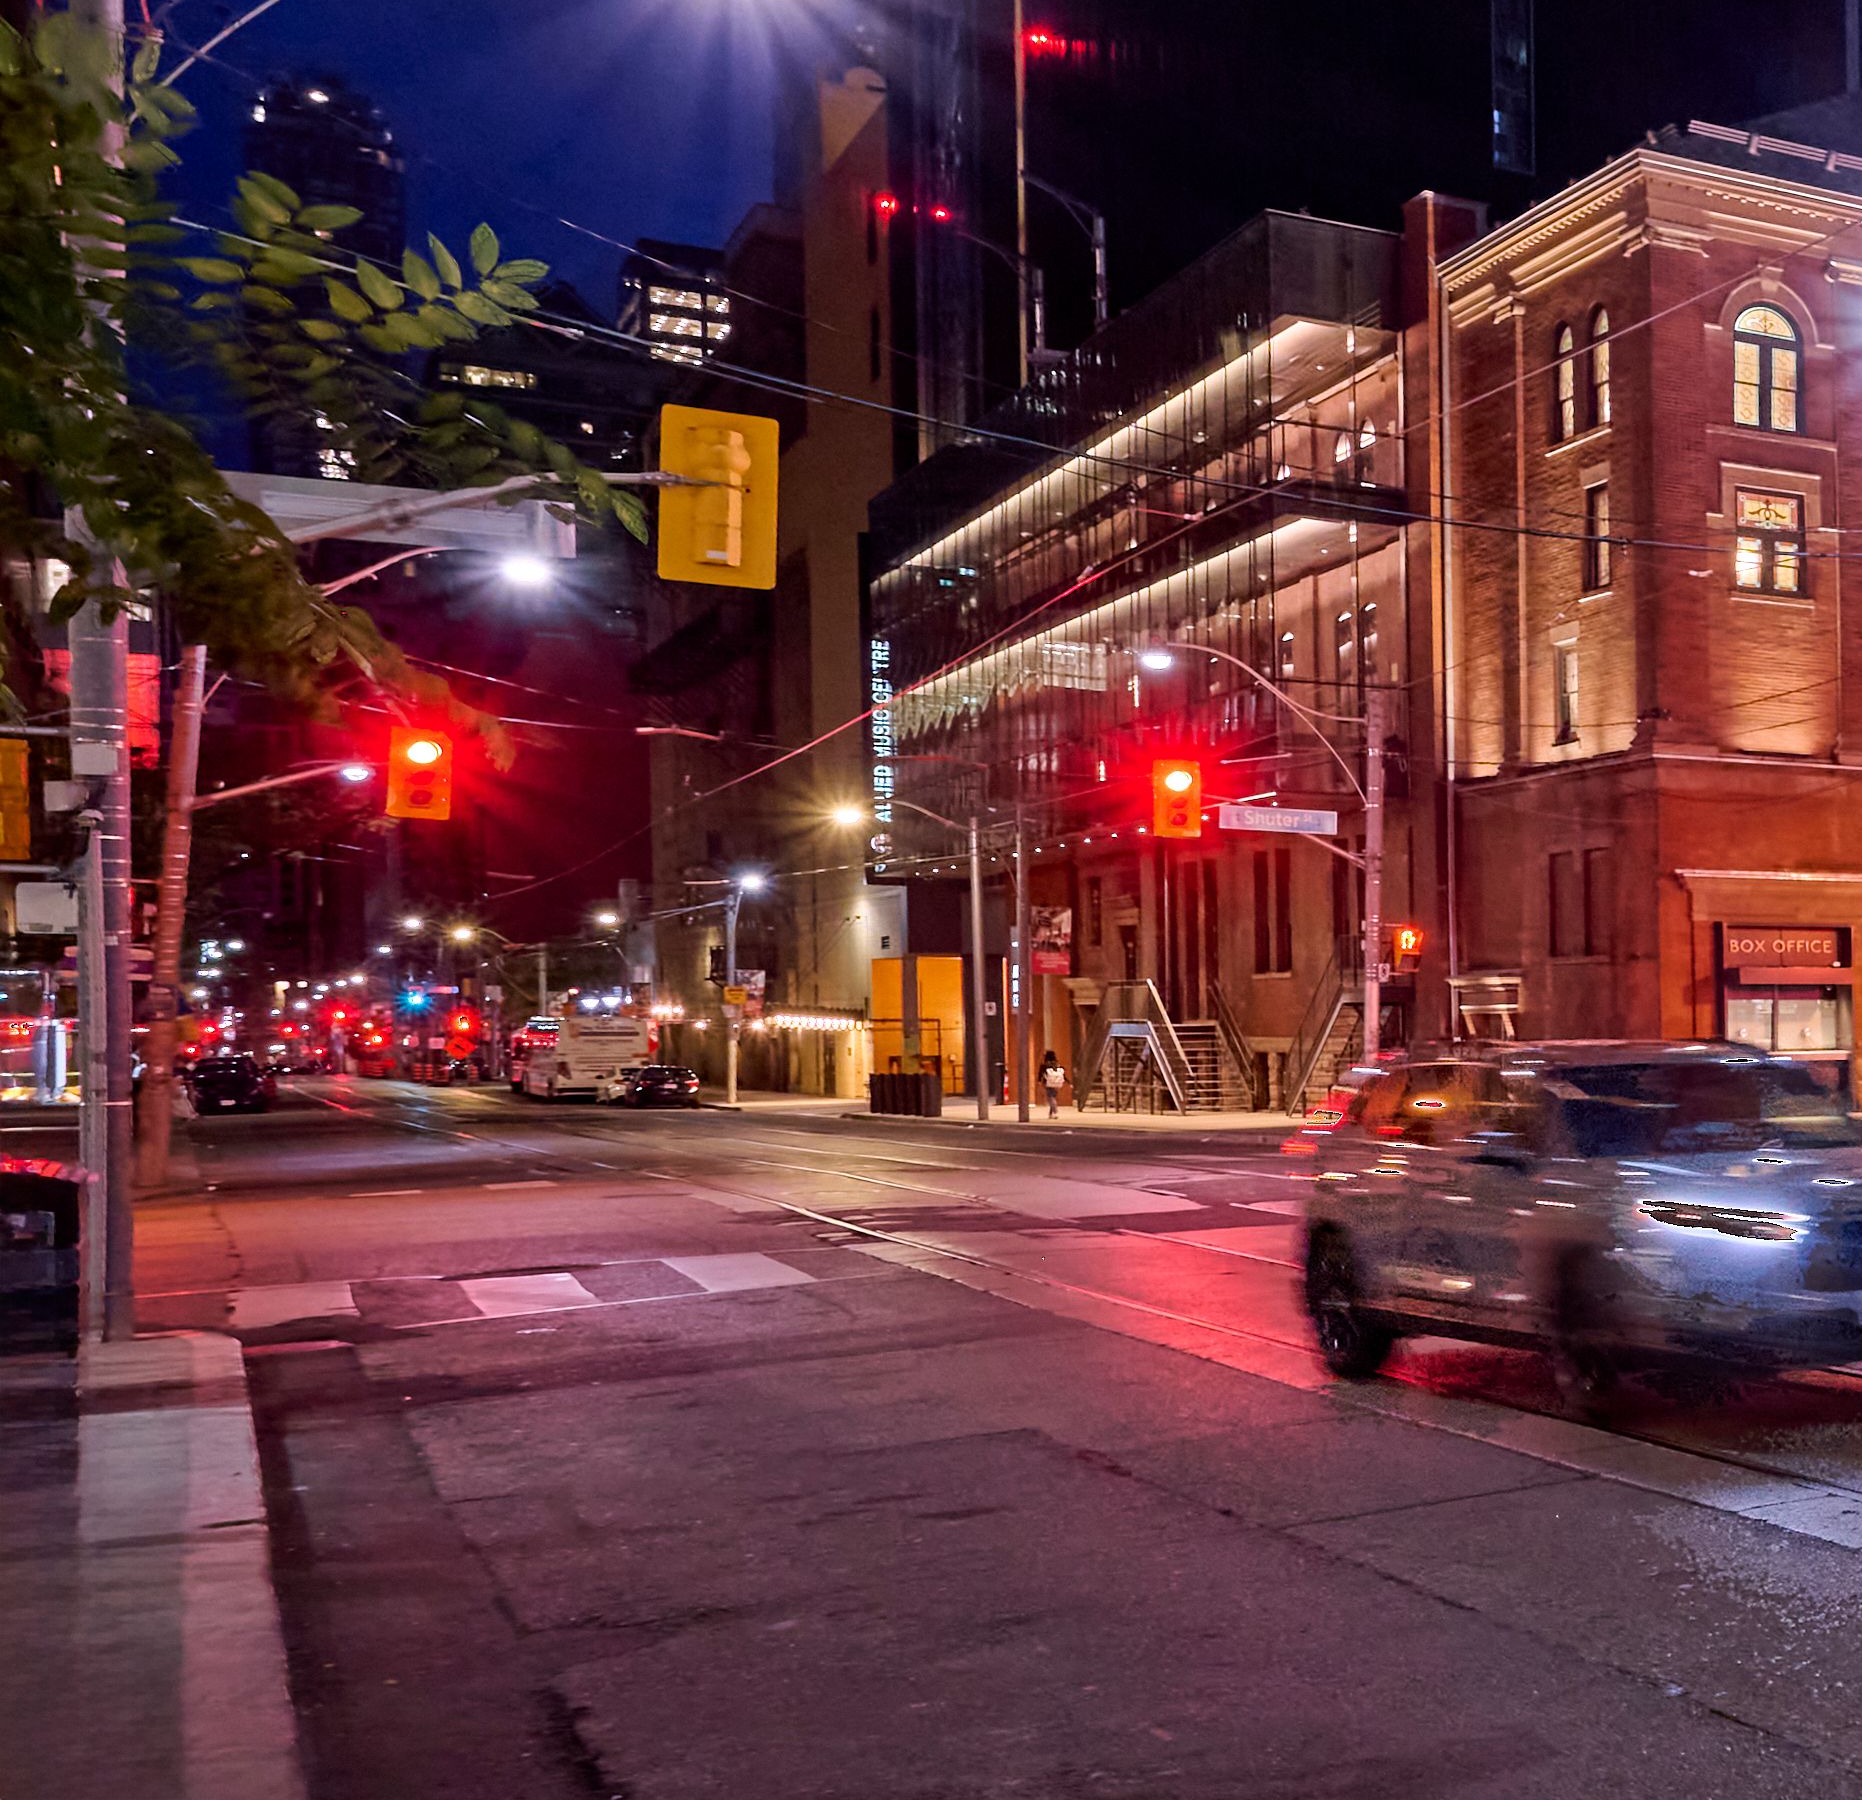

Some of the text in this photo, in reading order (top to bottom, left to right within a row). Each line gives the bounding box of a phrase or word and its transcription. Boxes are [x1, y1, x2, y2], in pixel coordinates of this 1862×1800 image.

[1244, 810, 1299, 827] Shuter
[1729, 939, 1833, 953] BOX OFFICE
